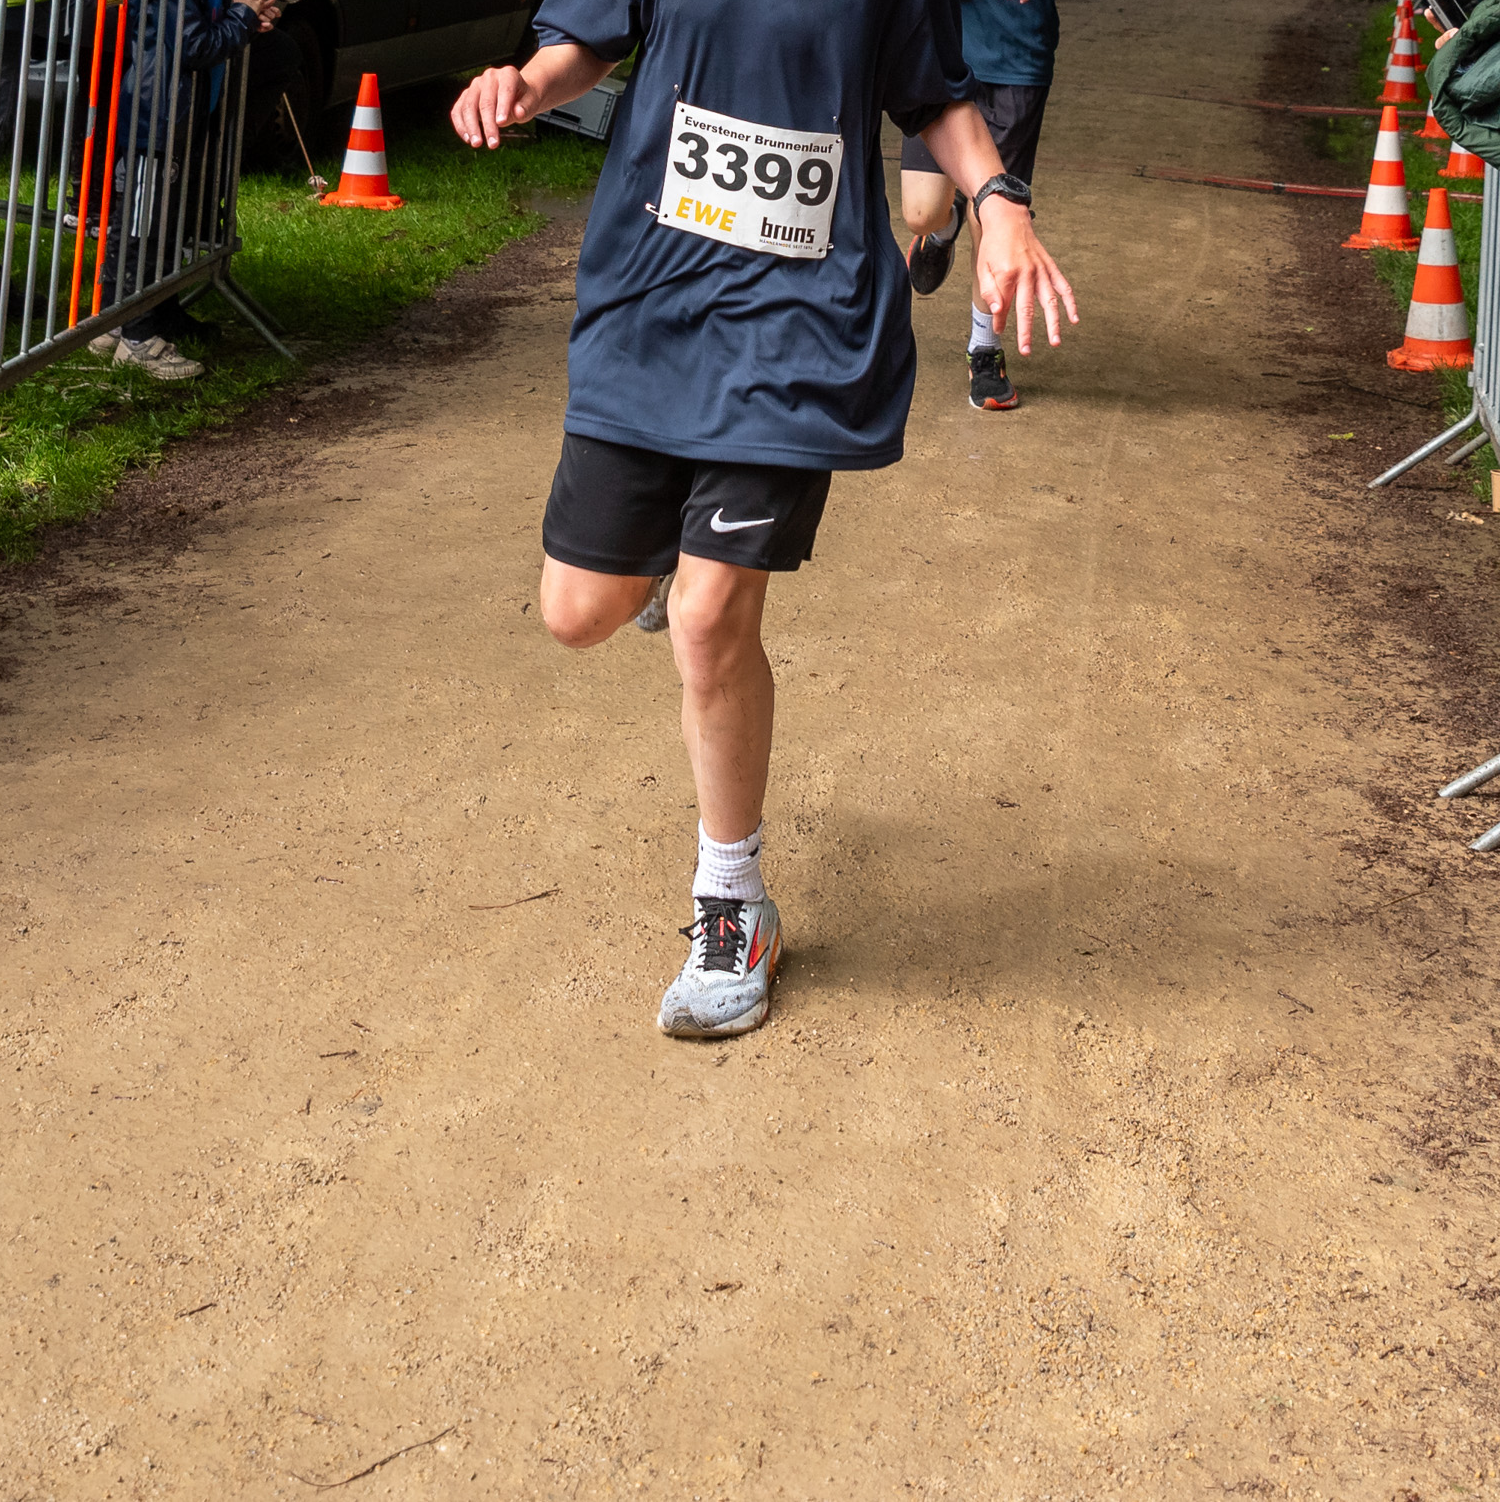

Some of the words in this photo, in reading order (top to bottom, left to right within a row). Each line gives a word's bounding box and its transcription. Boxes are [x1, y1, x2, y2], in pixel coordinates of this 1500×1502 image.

[684, 115, 751, 142] Everstener
[754, 134, 834, 154] Brunnenlauf
[673, 131, 834, 207] 3399
[675, 196, 737, 232] EWE
[760, 216, 816, 244] bruns
